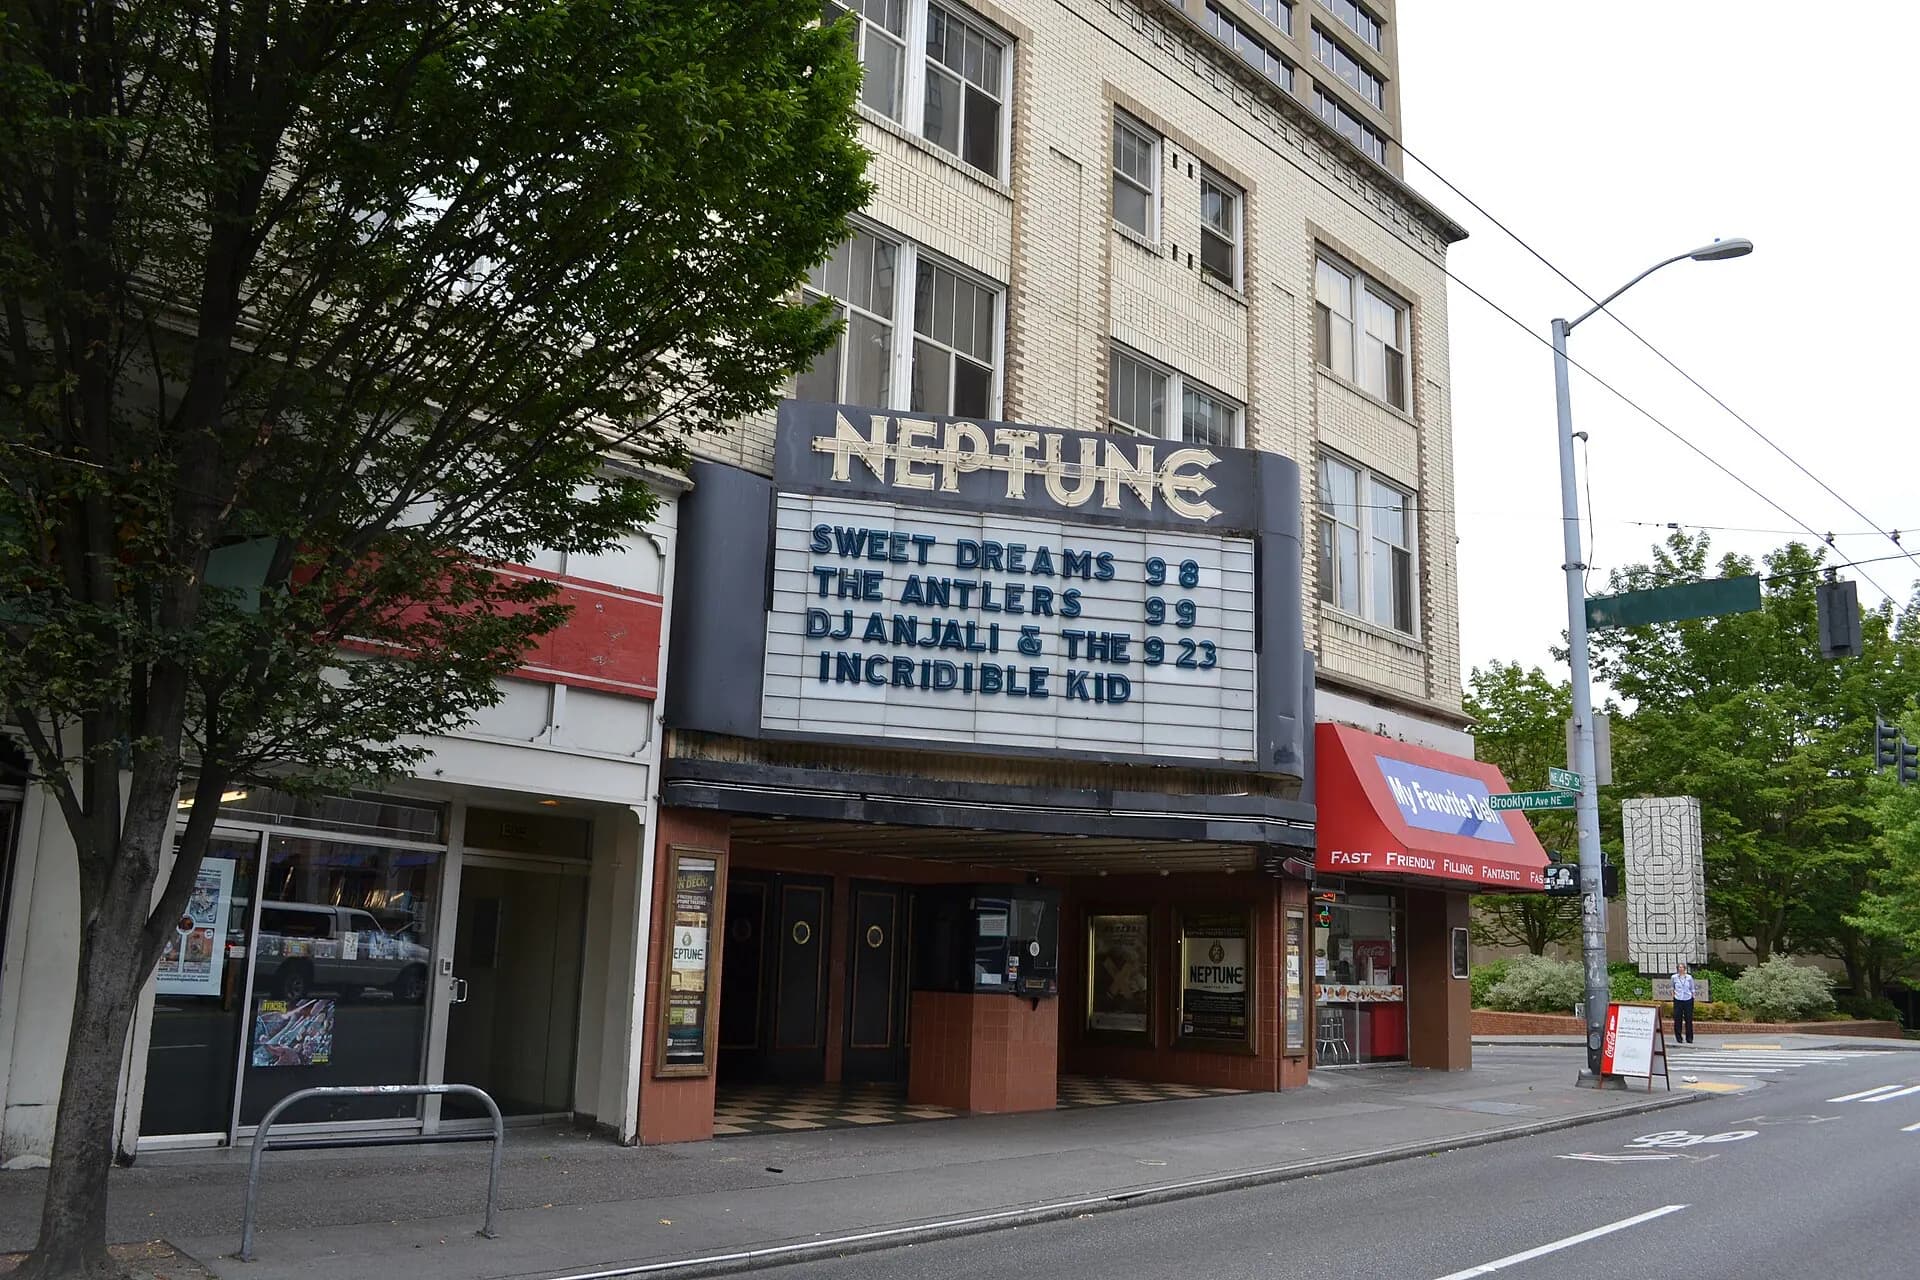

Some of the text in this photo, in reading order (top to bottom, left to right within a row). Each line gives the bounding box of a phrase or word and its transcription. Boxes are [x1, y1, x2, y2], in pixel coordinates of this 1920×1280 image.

[811, 410, 1222, 522] NEPTUNE
[810, 523, 936, 565] SWEET
[956, 538, 1115, 582] DREAMS
[813, 566, 884, 600] THE
[900, 573, 1082, 618] ANTLERS
[806, 607, 854, 640] DJ
[861, 611, 999, 654] ANJALI
[1016, 624, 1042, 656] &
[1062, 628, 1132, 664] THE
[818, 649, 1132, 704] INCRIDIBLE KID
[1387, 775, 1419, 815] My
[1411, 780, 1473, 820] Favorite
[1551, 771, 1558, 783] NE
[1490, 795, 1562, 809] Brooklyn Ave NE
[1331, 850, 1372, 864] FAST
[1386, 852, 1436, 871] FRIENDLY
[1443, 859, 1474, 876] FILLING
[1482, 865, 1521, 881] FANTASTIC
[1530, 871, 1544, 884] FAS
[673, 948, 704, 960] EPTUNE
[1189, 965, 1244, 984] NEPTUNE
